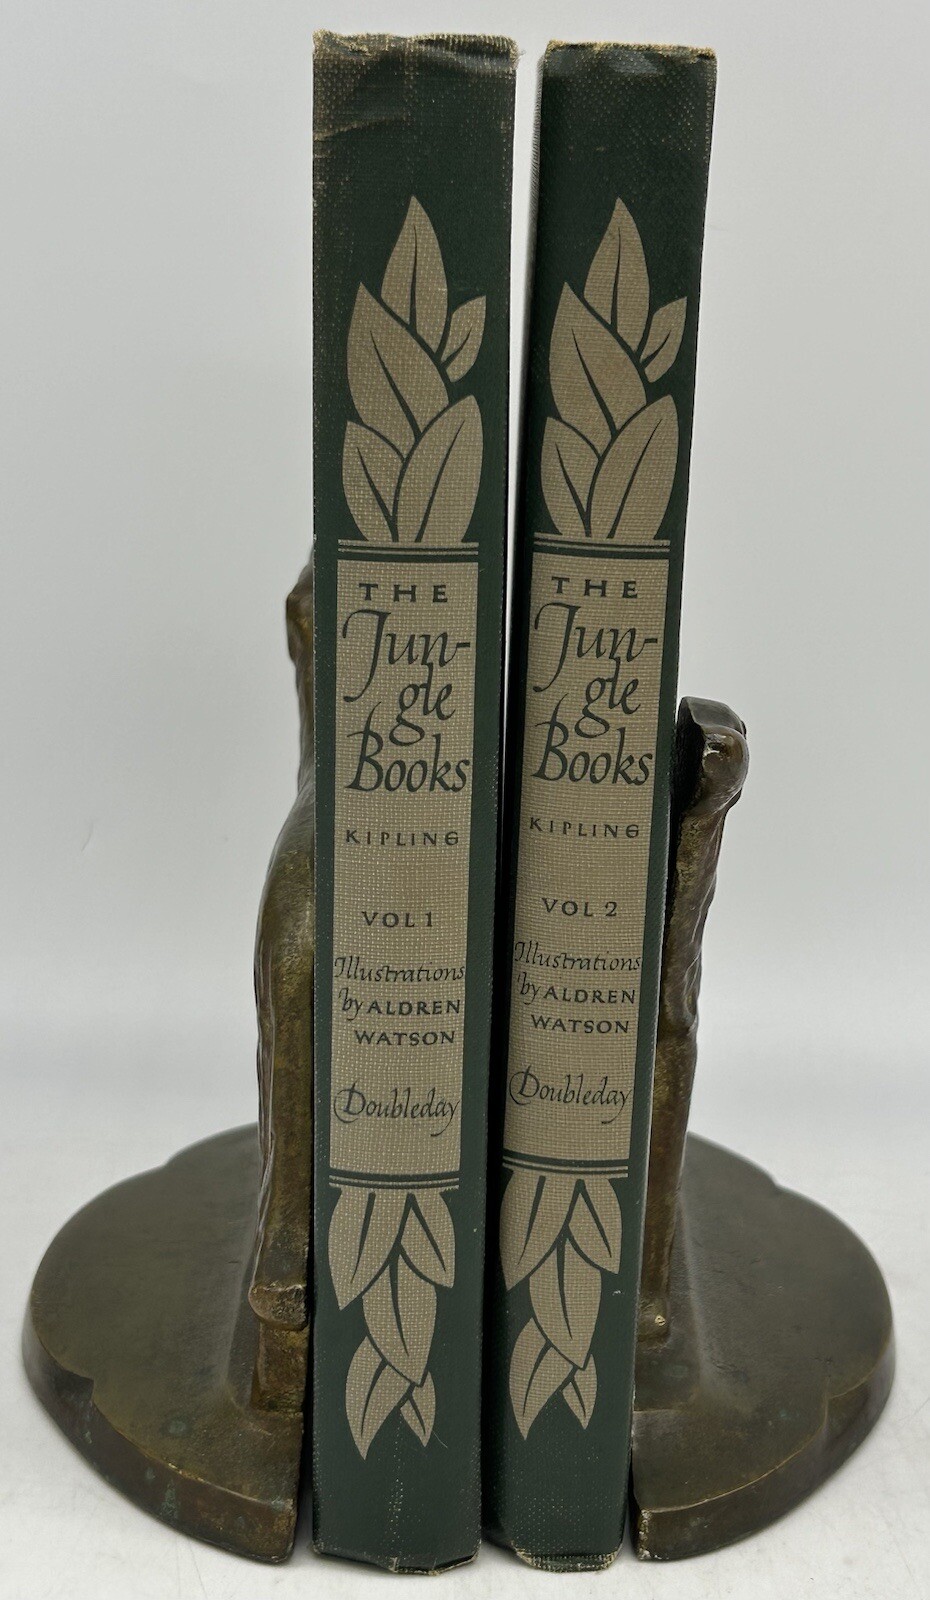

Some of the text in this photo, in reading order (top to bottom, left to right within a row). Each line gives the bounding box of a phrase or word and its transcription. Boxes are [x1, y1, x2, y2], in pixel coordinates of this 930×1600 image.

[359, 583, 448, 602] THE
[551, 577, 638, 598] THE
[342, 609, 470, 702] Jun-
[533, 602, 658, 692] Jun-
[389, 663, 456, 747] gle
[574, 657, 641, 739] gle
[345, 702, 470, 792] Books
[531, 693, 653, 786] Books
[346, 830, 459, 846] KIPLING
[530, 817, 639, 838] KIPLING
[362, 911, 433, 927] VOL 1
[542, 898, 617, 917] VOL 2
[334, 955, 465, 982] Illustrations
[514, 941, 641, 971] Illustrations
[338, 988, 460, 1020] by ALDREN
[517, 972, 635, 1005] by ALDREN
[354, 1030, 455, 1046] WATSON
[531, 1014, 629, 1034] WATSON
[333, 1079, 459, 1137] Doubleday
[509, 1064, 633, 1124] Doubleday
